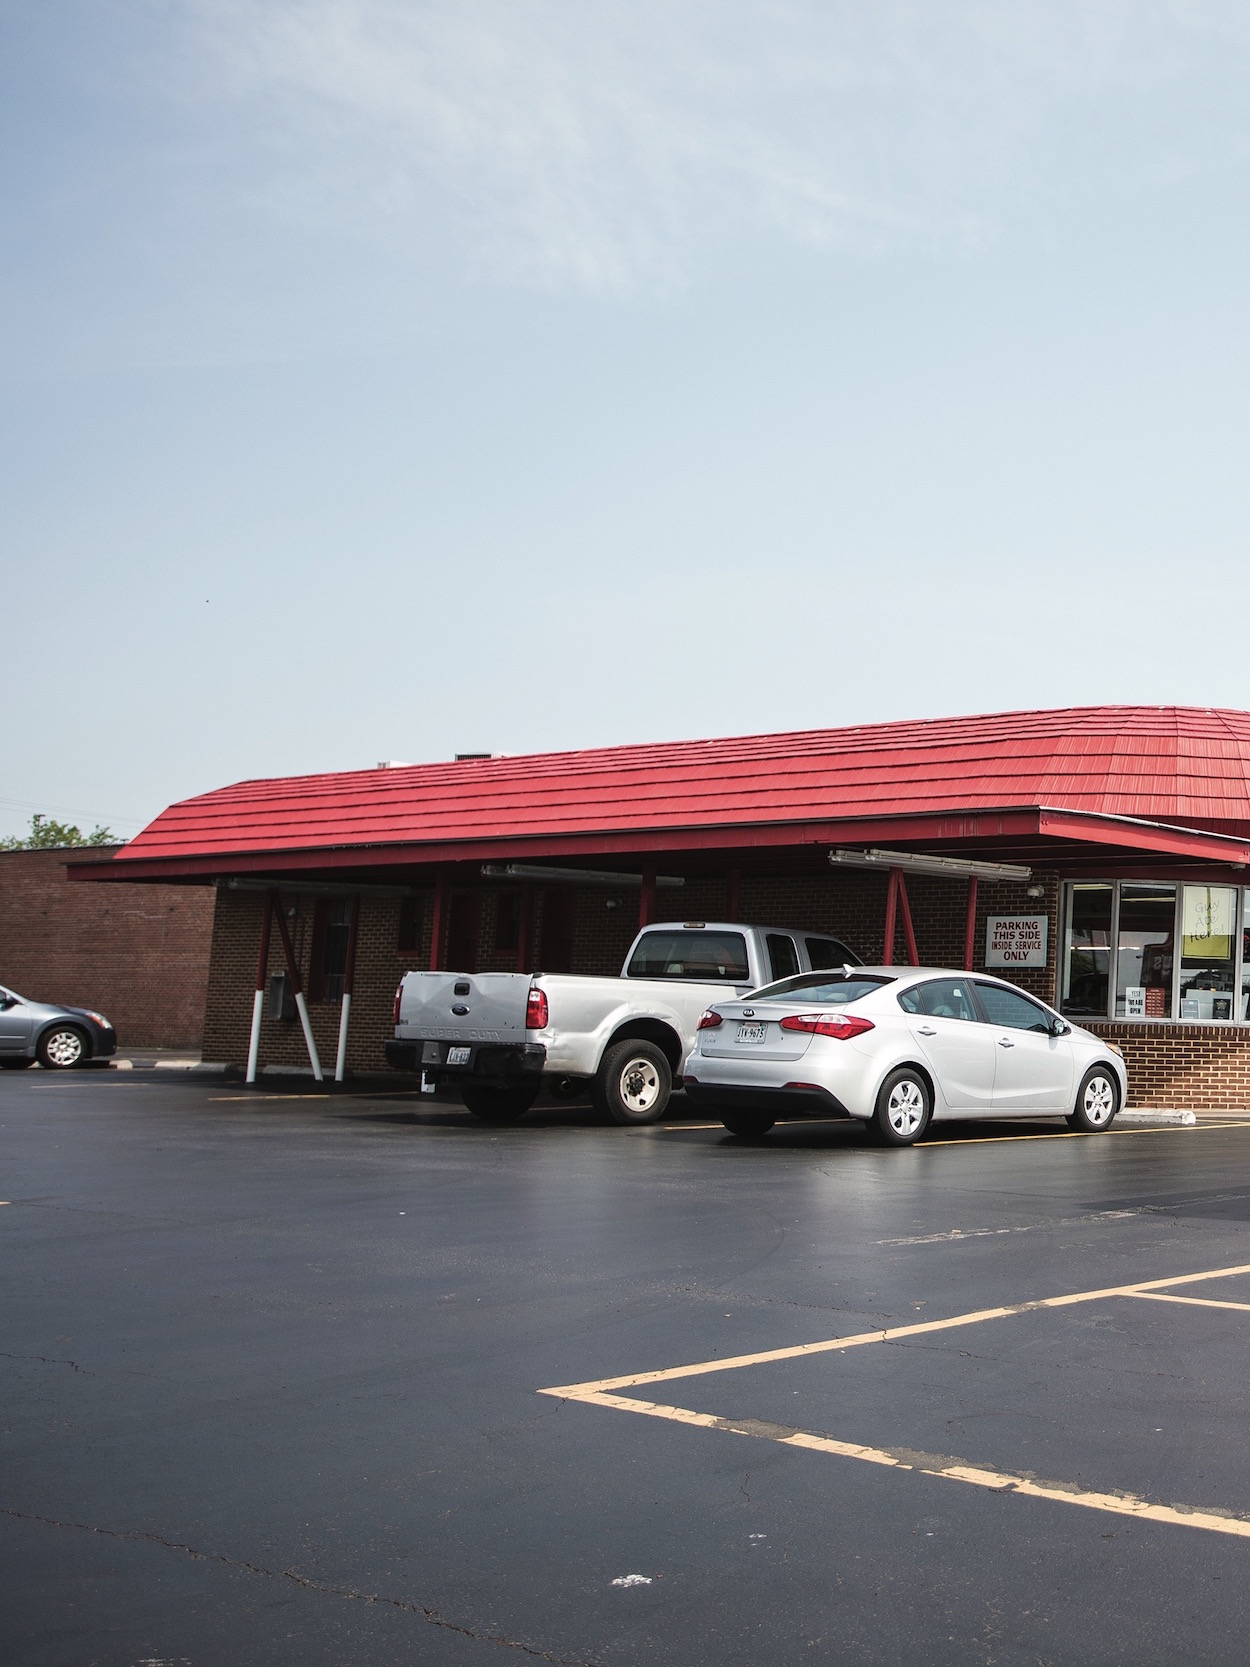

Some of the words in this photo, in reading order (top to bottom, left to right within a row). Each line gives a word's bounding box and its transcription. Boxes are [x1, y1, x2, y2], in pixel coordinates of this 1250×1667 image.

[1195, 900, 1220, 913] Guy
[995, 921, 1038, 930] PARKING
[1195, 915, 1218, 928] Ate
[993, 931, 1016, 940] THIS
[1018, 931, 1041, 940] SIDE
[1189, 924, 1225, 943] Here!
[991, 941, 1013, 950] INSIDE
[1015, 941, 1041, 950] SERVICE
[1003, 951, 1030, 961] ONLY
[1130, 1007, 1141, 1015] OPEN
[420, 1028, 461, 1039] SUPER
[468, 1029, 502, 1040] DUTY
